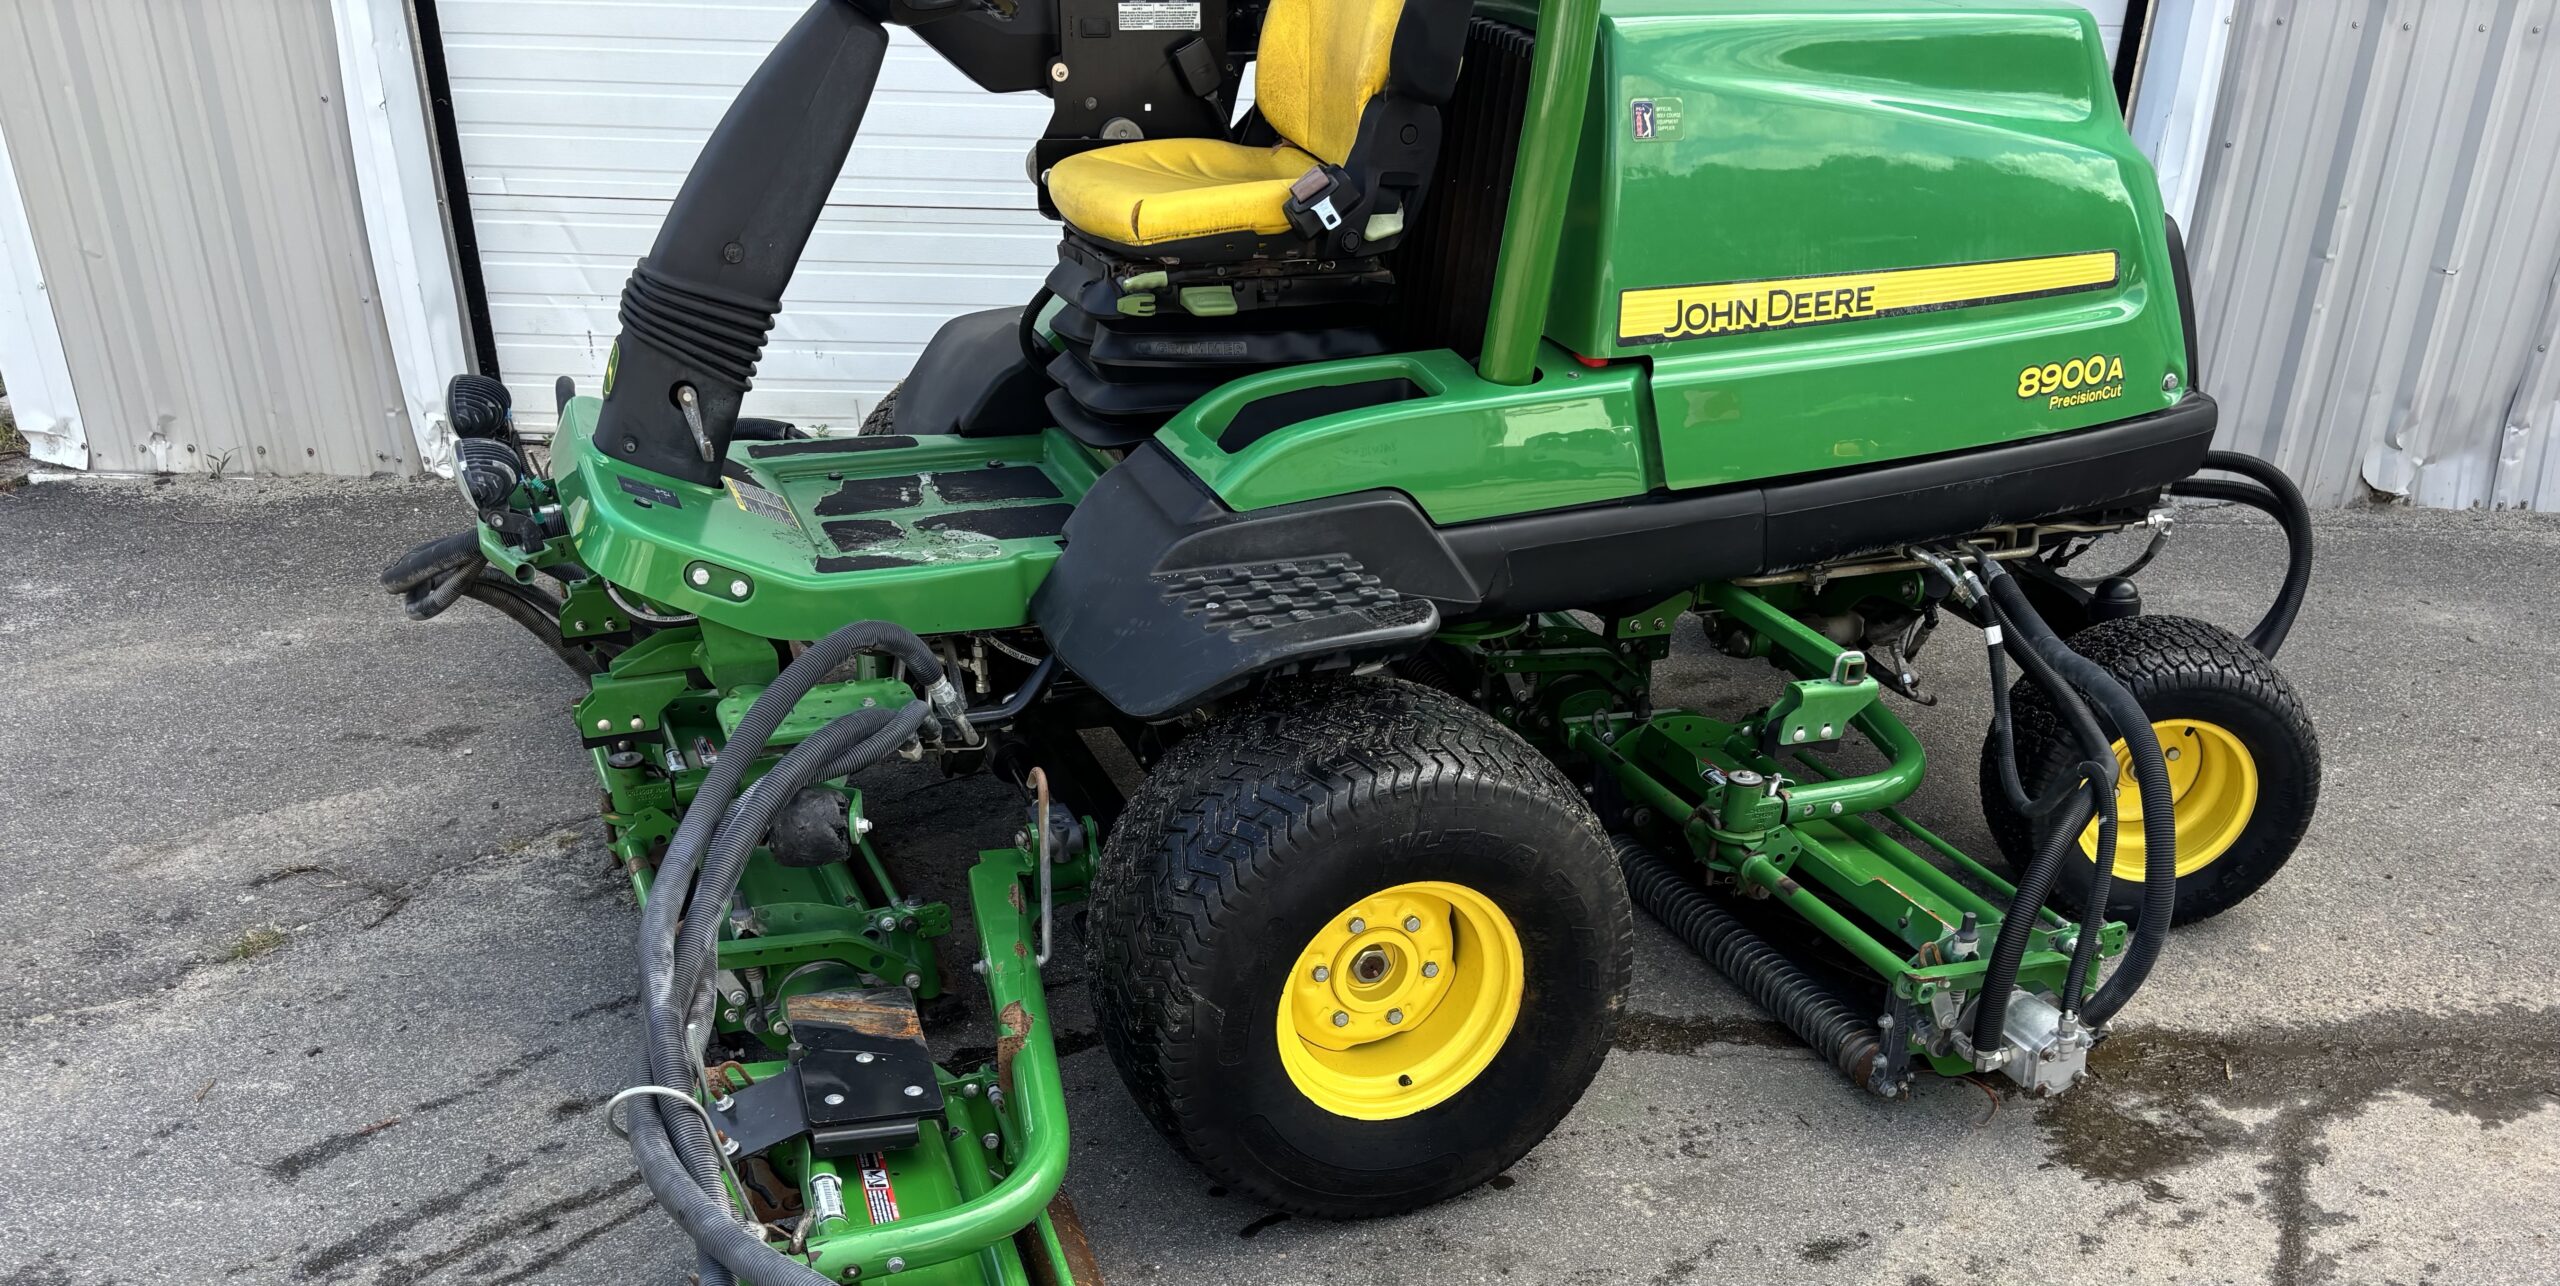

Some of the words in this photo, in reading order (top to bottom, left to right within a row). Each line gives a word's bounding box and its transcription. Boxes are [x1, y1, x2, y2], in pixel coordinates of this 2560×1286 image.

[1664, 298, 1758, 333] JOHN
[1767, 286, 1875, 322] DEERE
[1156, 342, 1246, 356] GRAMMER
[2017, 354, 2124, 398] 8900A
[2049, 384, 2122, 409] PrecisionCut
